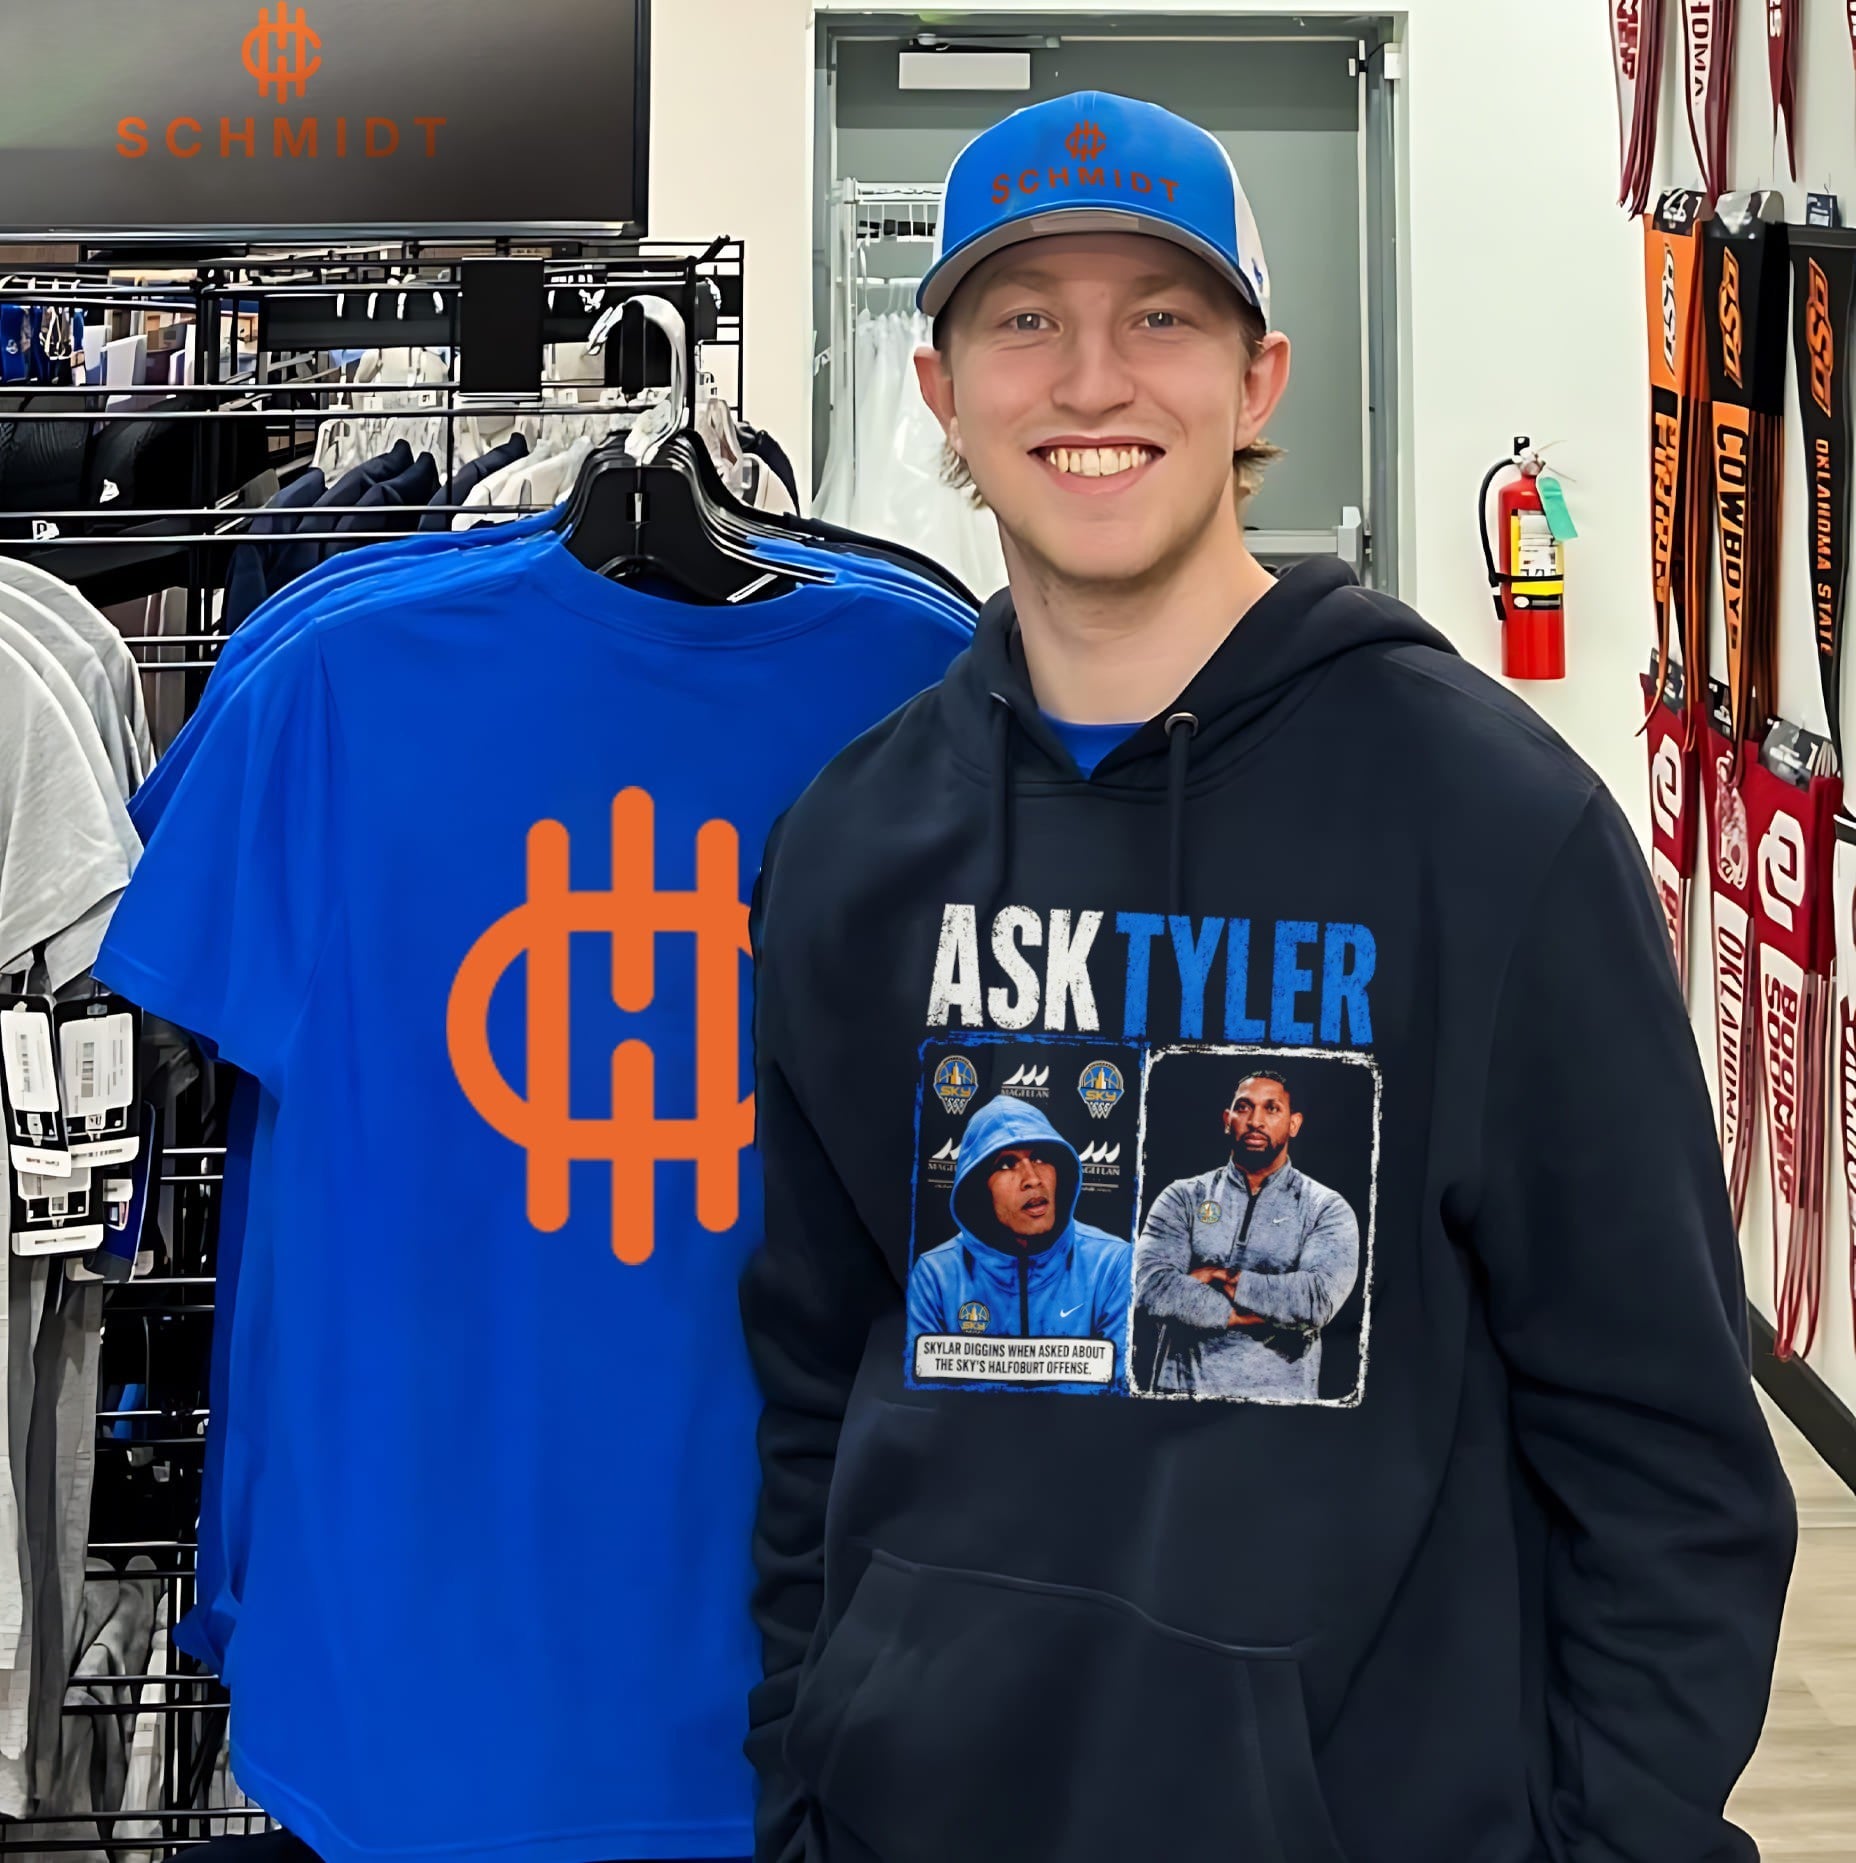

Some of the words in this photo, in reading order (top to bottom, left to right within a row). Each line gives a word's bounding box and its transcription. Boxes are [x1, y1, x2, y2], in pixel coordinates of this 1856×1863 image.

[116, 117, 447, 159] SCHMIDT
[991, 167, 1180, 205] SCHMIDT
[925, 903, 1105, 1032] ASK
[1115, 911, 1378, 1046] TYLER
[1718, 926, 1745, 1144] OKLAHOMA
[939, 1085, 972, 1098] SKY
[1085, 1090, 1117, 1102] SKY
[923, 1341, 962, 1356] SKYLAR
[963, 1342, 1006, 1358] DIGGINS
[1007, 1344, 1036, 1358] WHEN
[1038, 1345, 1070, 1359] ASKED
[1071, 1346, 1106, 1360] ABOUT
[935, 1358, 954, 1372] THE
[956, 1359, 986, 1373] SKY'S
[1046, 1361, 1092, 1376] OFFENSE.
